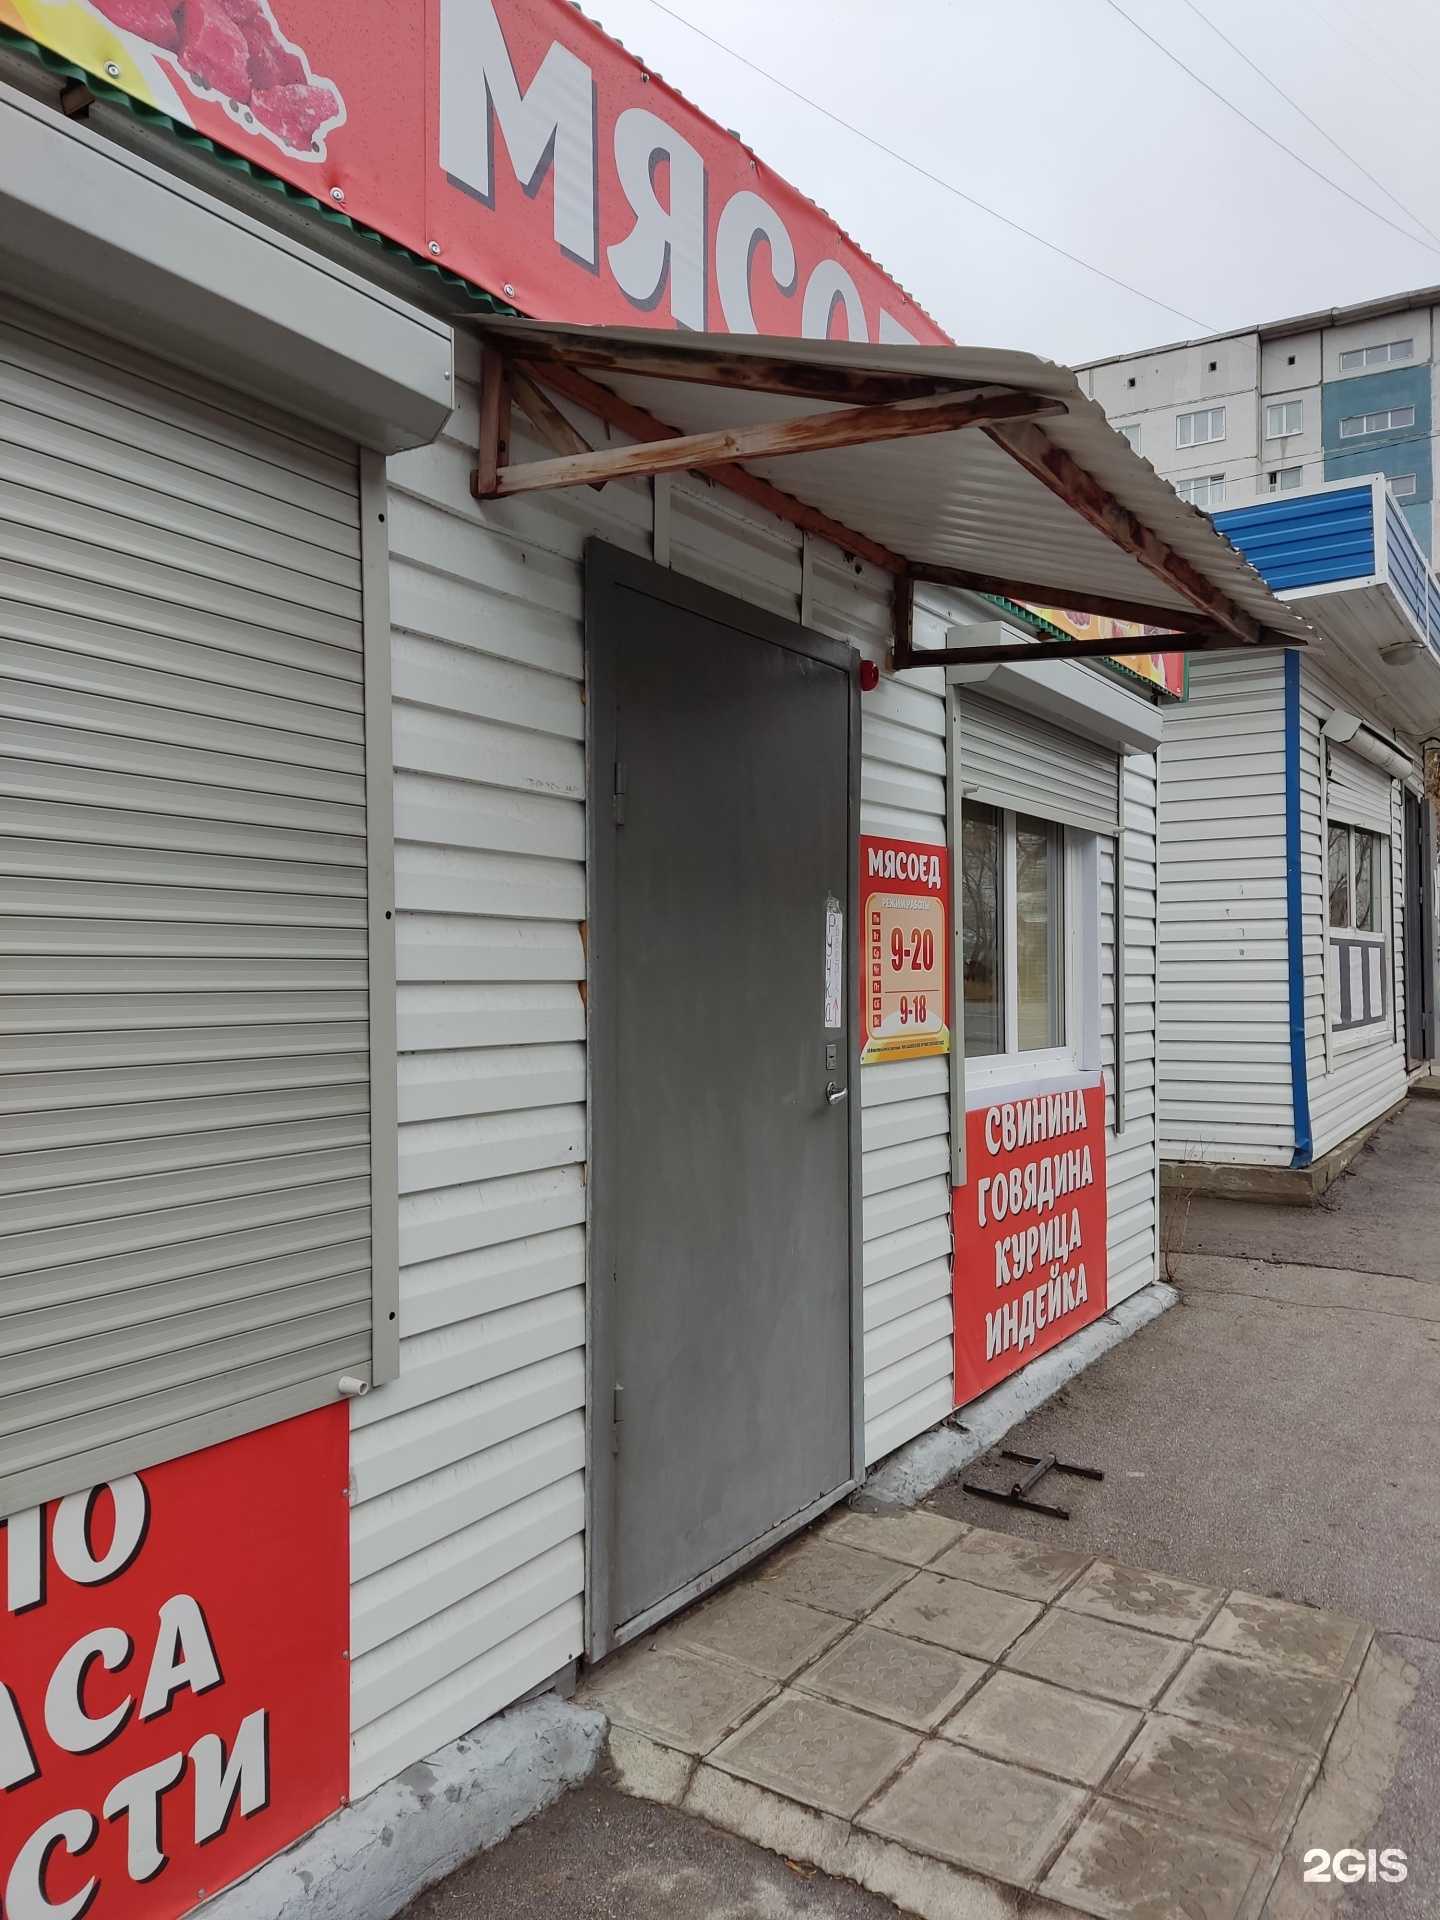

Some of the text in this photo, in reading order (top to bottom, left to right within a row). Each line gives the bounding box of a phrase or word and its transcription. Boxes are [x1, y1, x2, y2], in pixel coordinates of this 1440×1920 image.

[867, 847, 941, 890] МЯСОЕД
[890, 927, 934, 973] 9-20
[899, 995, 927, 1025] 9-18
[985, 1089, 1088, 1156] СВИНИНА
[978, 1145, 1094, 1228] ГОВЯДИНА
[994, 1207, 1082, 1289] КУРИЦА
[985, 1262, 1088, 1362] ИНДЕЙКА
